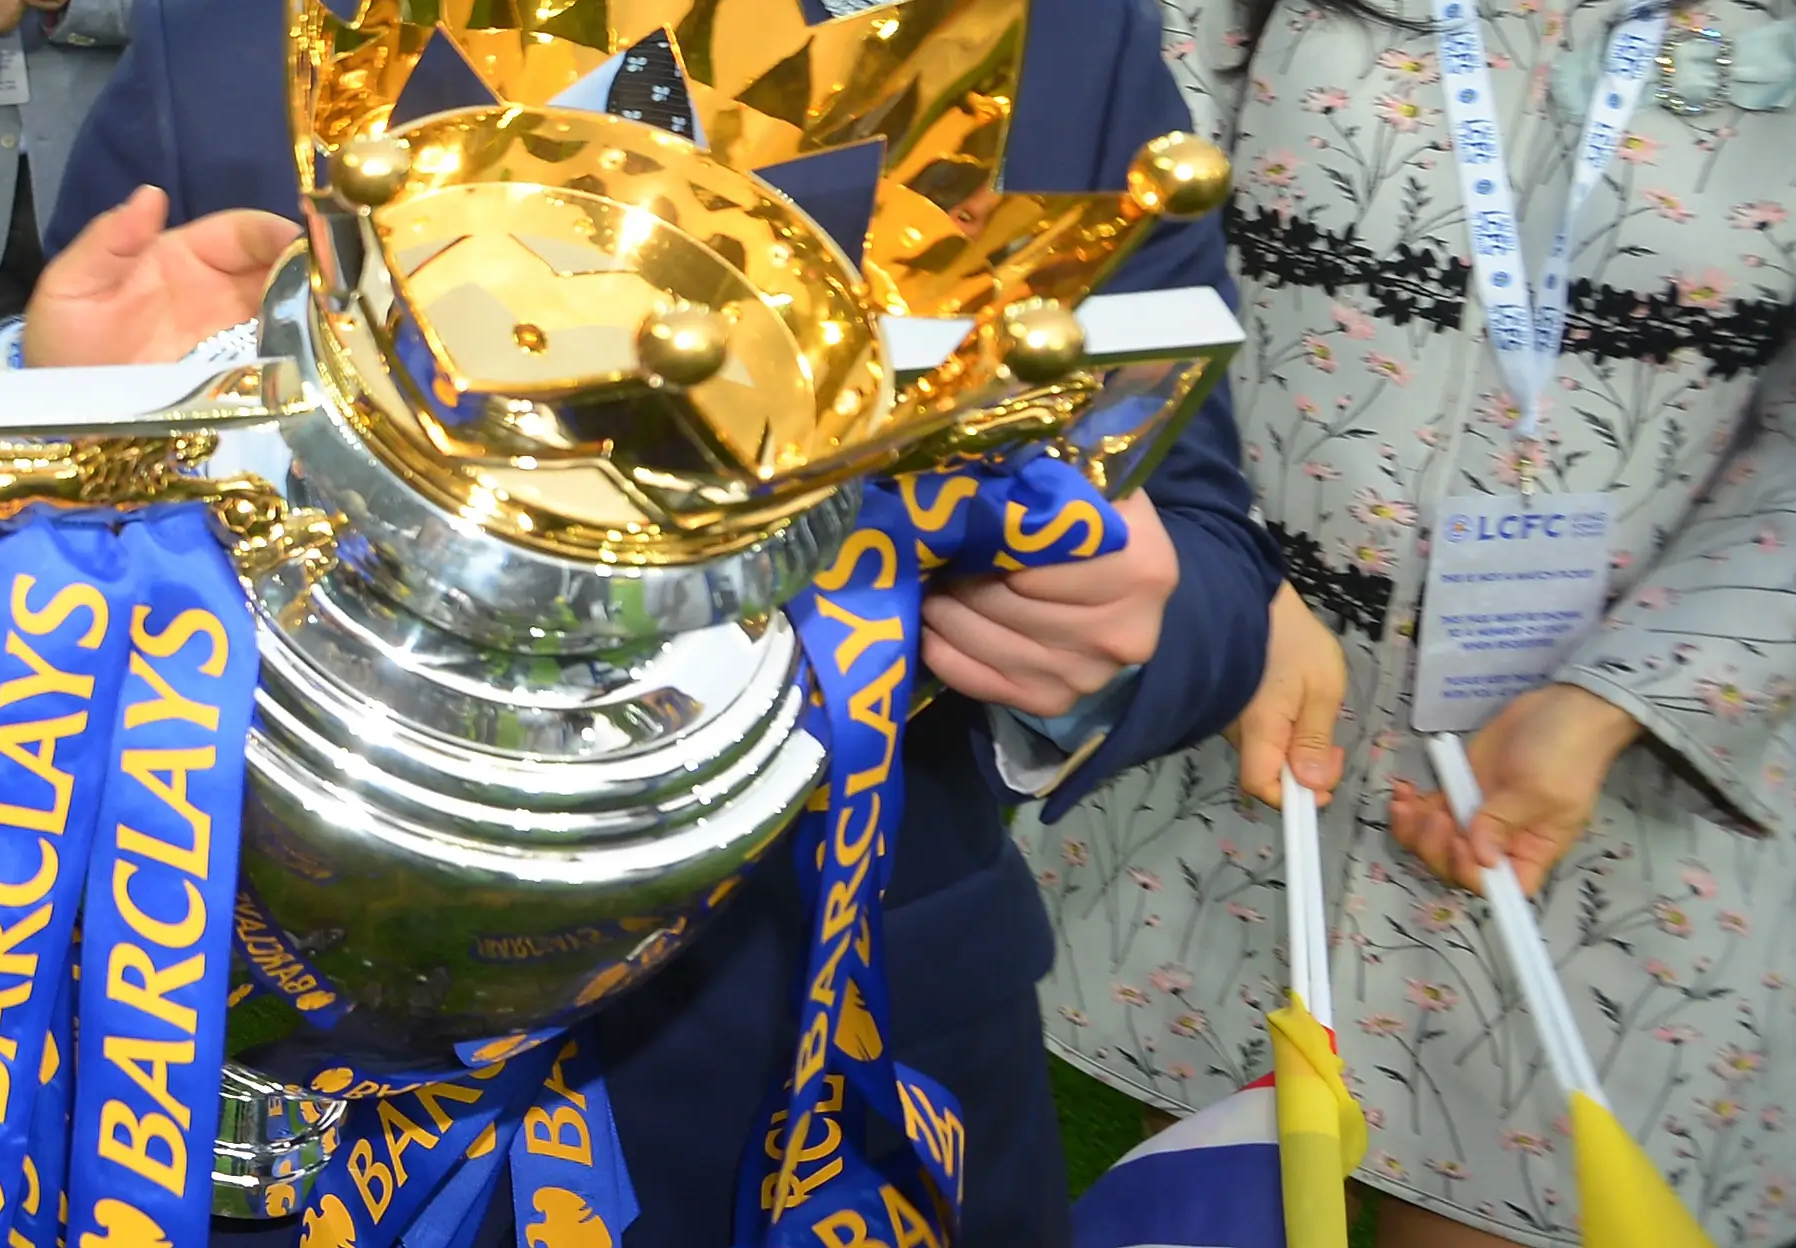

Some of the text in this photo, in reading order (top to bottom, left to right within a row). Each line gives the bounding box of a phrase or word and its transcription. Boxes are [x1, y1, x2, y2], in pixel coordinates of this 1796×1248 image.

[795, 527, 907, 1096] BARCLAYS
[1477, 513, 1566, 541] LCFC
[97, 604, 229, 1199] BARCLAYS
